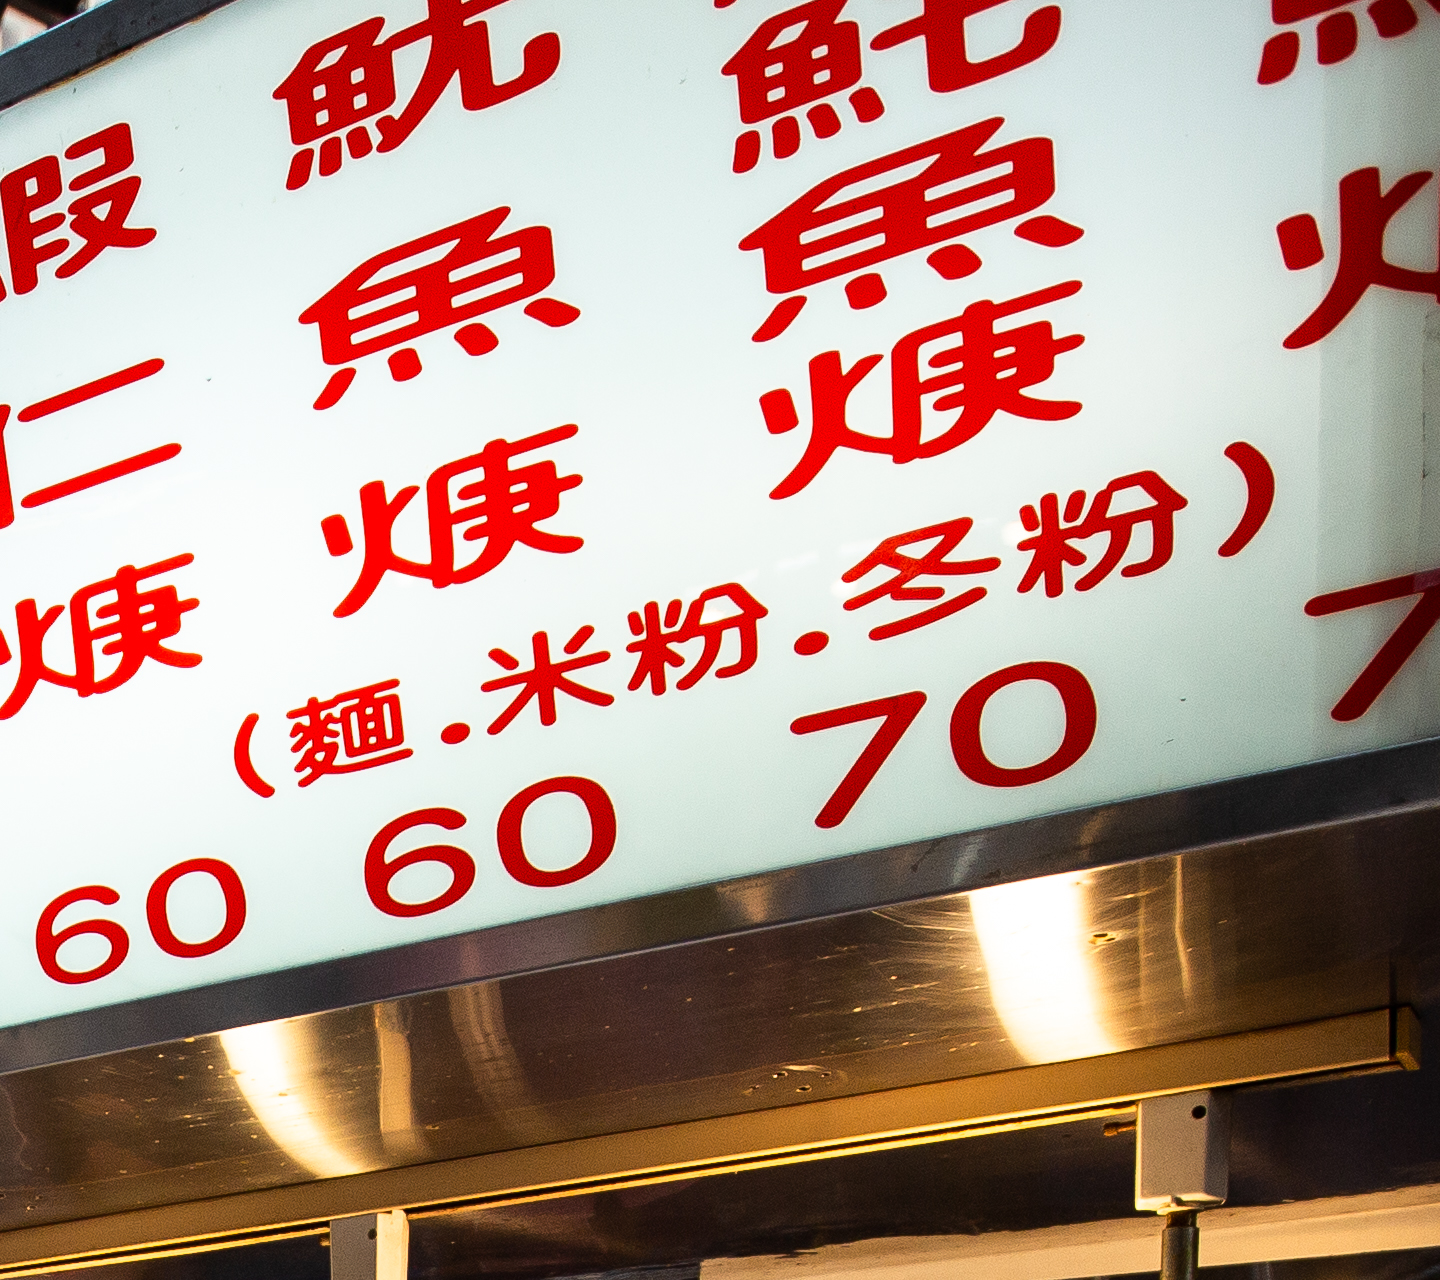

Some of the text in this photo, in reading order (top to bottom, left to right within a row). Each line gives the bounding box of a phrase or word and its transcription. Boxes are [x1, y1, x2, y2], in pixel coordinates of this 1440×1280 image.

[790, 661, 1096, 829] 70
[364, 776, 616, 918] 60
[35, 858, 246, 984] 60
